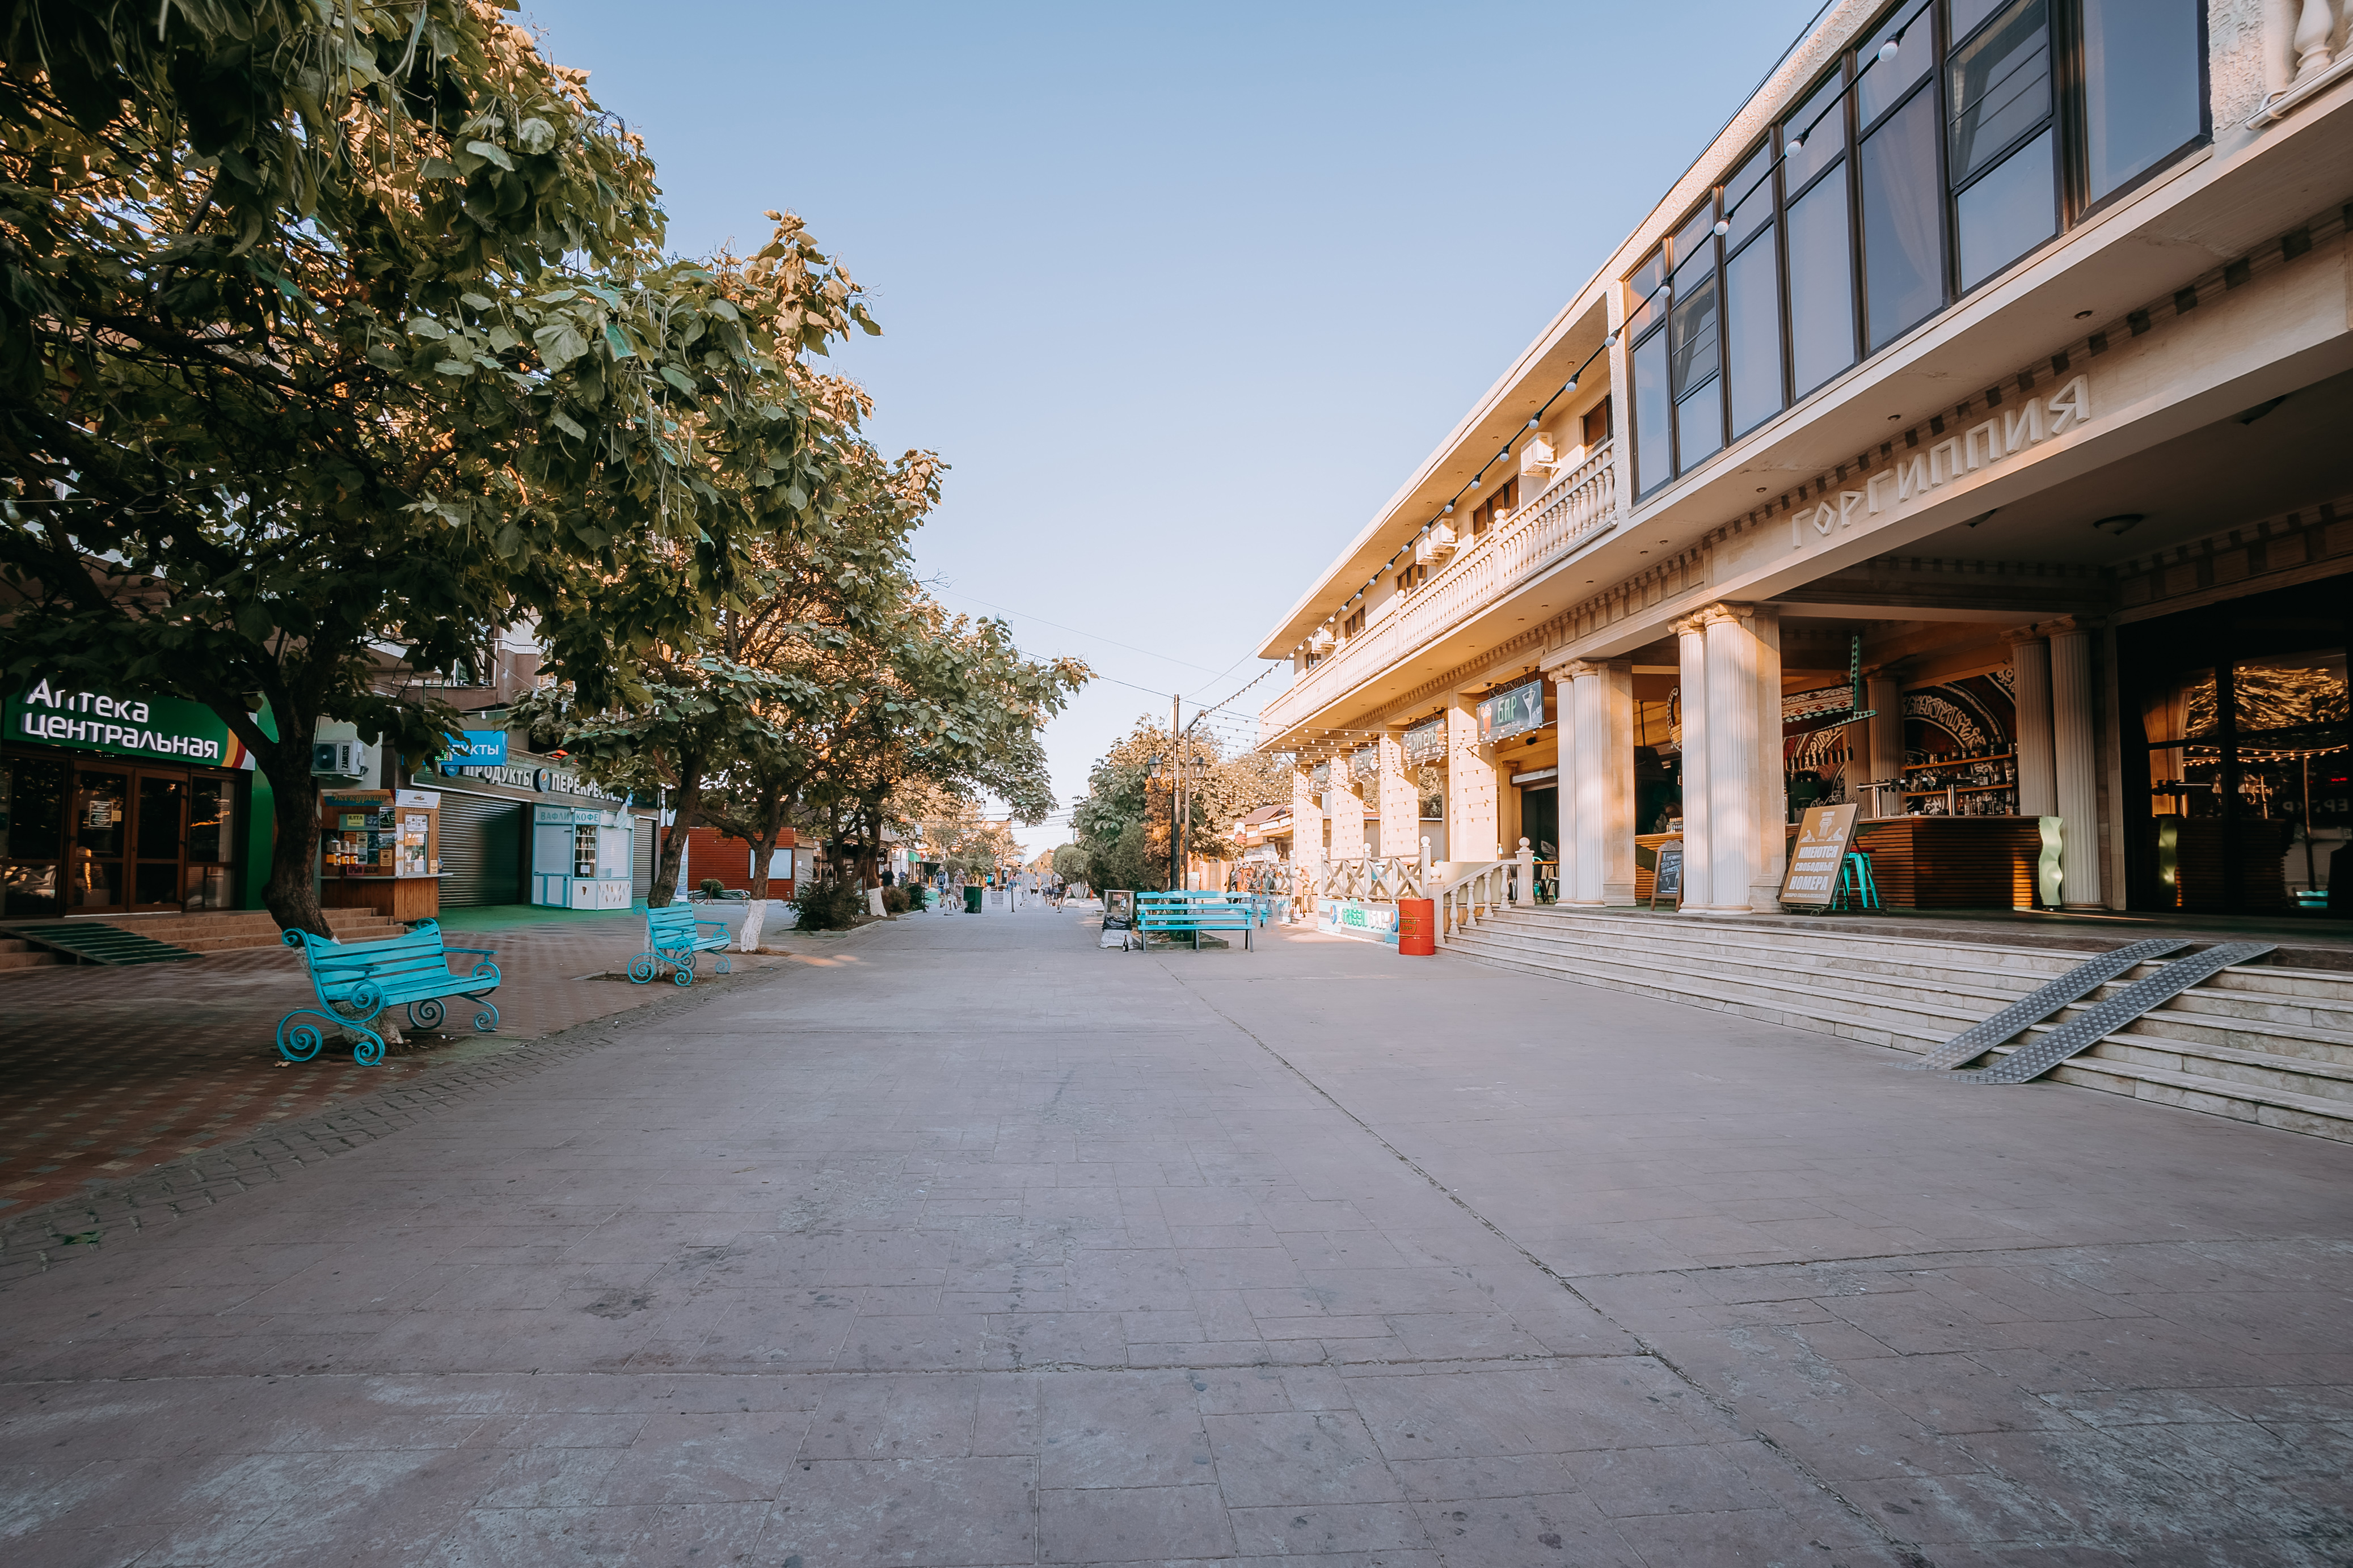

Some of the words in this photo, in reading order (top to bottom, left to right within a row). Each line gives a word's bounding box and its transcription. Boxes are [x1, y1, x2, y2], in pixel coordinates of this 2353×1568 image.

[1791, 373, 2091, 549] ГОРГИППИЯ
[1497, 695, 1517, 723] БАР
[23, 712, 219, 759] центральная
[341, 745, 350, 769] ZANUSSI
[462, 766, 534, 787] ПРОДУКТЫ
[331, 792, 387, 804] Экскурсии
[541, 812, 570, 821] ВАФЛИ
[576, 813, 598, 822] КОФЕ
[1798, 846, 1839, 859] ИМЕЮТСЯ
[1794, 861, 1835, 873] СВОБОДНЫЕ
[1789, 876, 1829, 891] НОМЕРА
[1342, 907, 1368, 928] GREEN
